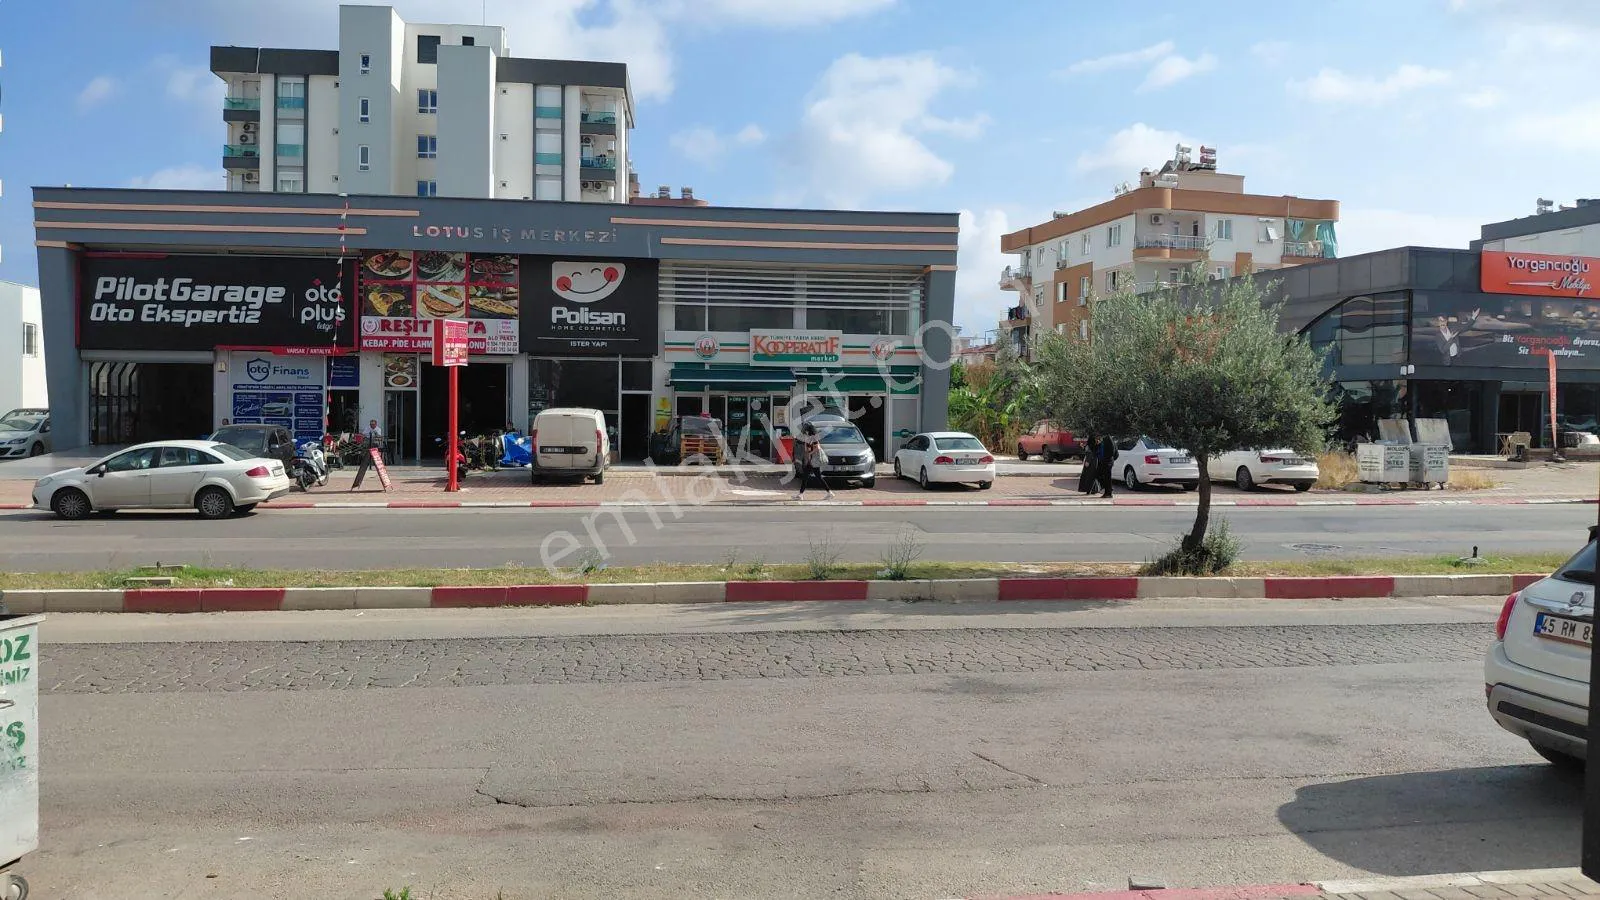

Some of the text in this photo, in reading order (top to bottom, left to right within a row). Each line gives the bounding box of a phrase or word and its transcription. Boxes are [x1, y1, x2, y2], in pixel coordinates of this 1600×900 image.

[413, 225, 617, 243] LOTUS İŞ MERKEZİ
[1507, 255, 1590, 275] Yorgancıoğlu
[94, 276, 286, 310] PilotGarage
[304, 284, 342, 302] oto
[90, 302, 262, 328] Oto Ekspertiz
[301, 303, 346, 324] plus
[551, 306, 626, 325] Polisan
[379, 318, 432, 336] REŞİT
[411, 339, 433, 348] LAHM
[1502, 334, 1514, 343] Biz
[1518, 345, 1529, 354] Siz
[250, 365, 310, 375] oto Finans
[1541, 617, 1555, 634] 45
[1561, 621, 1577, 637] RM
